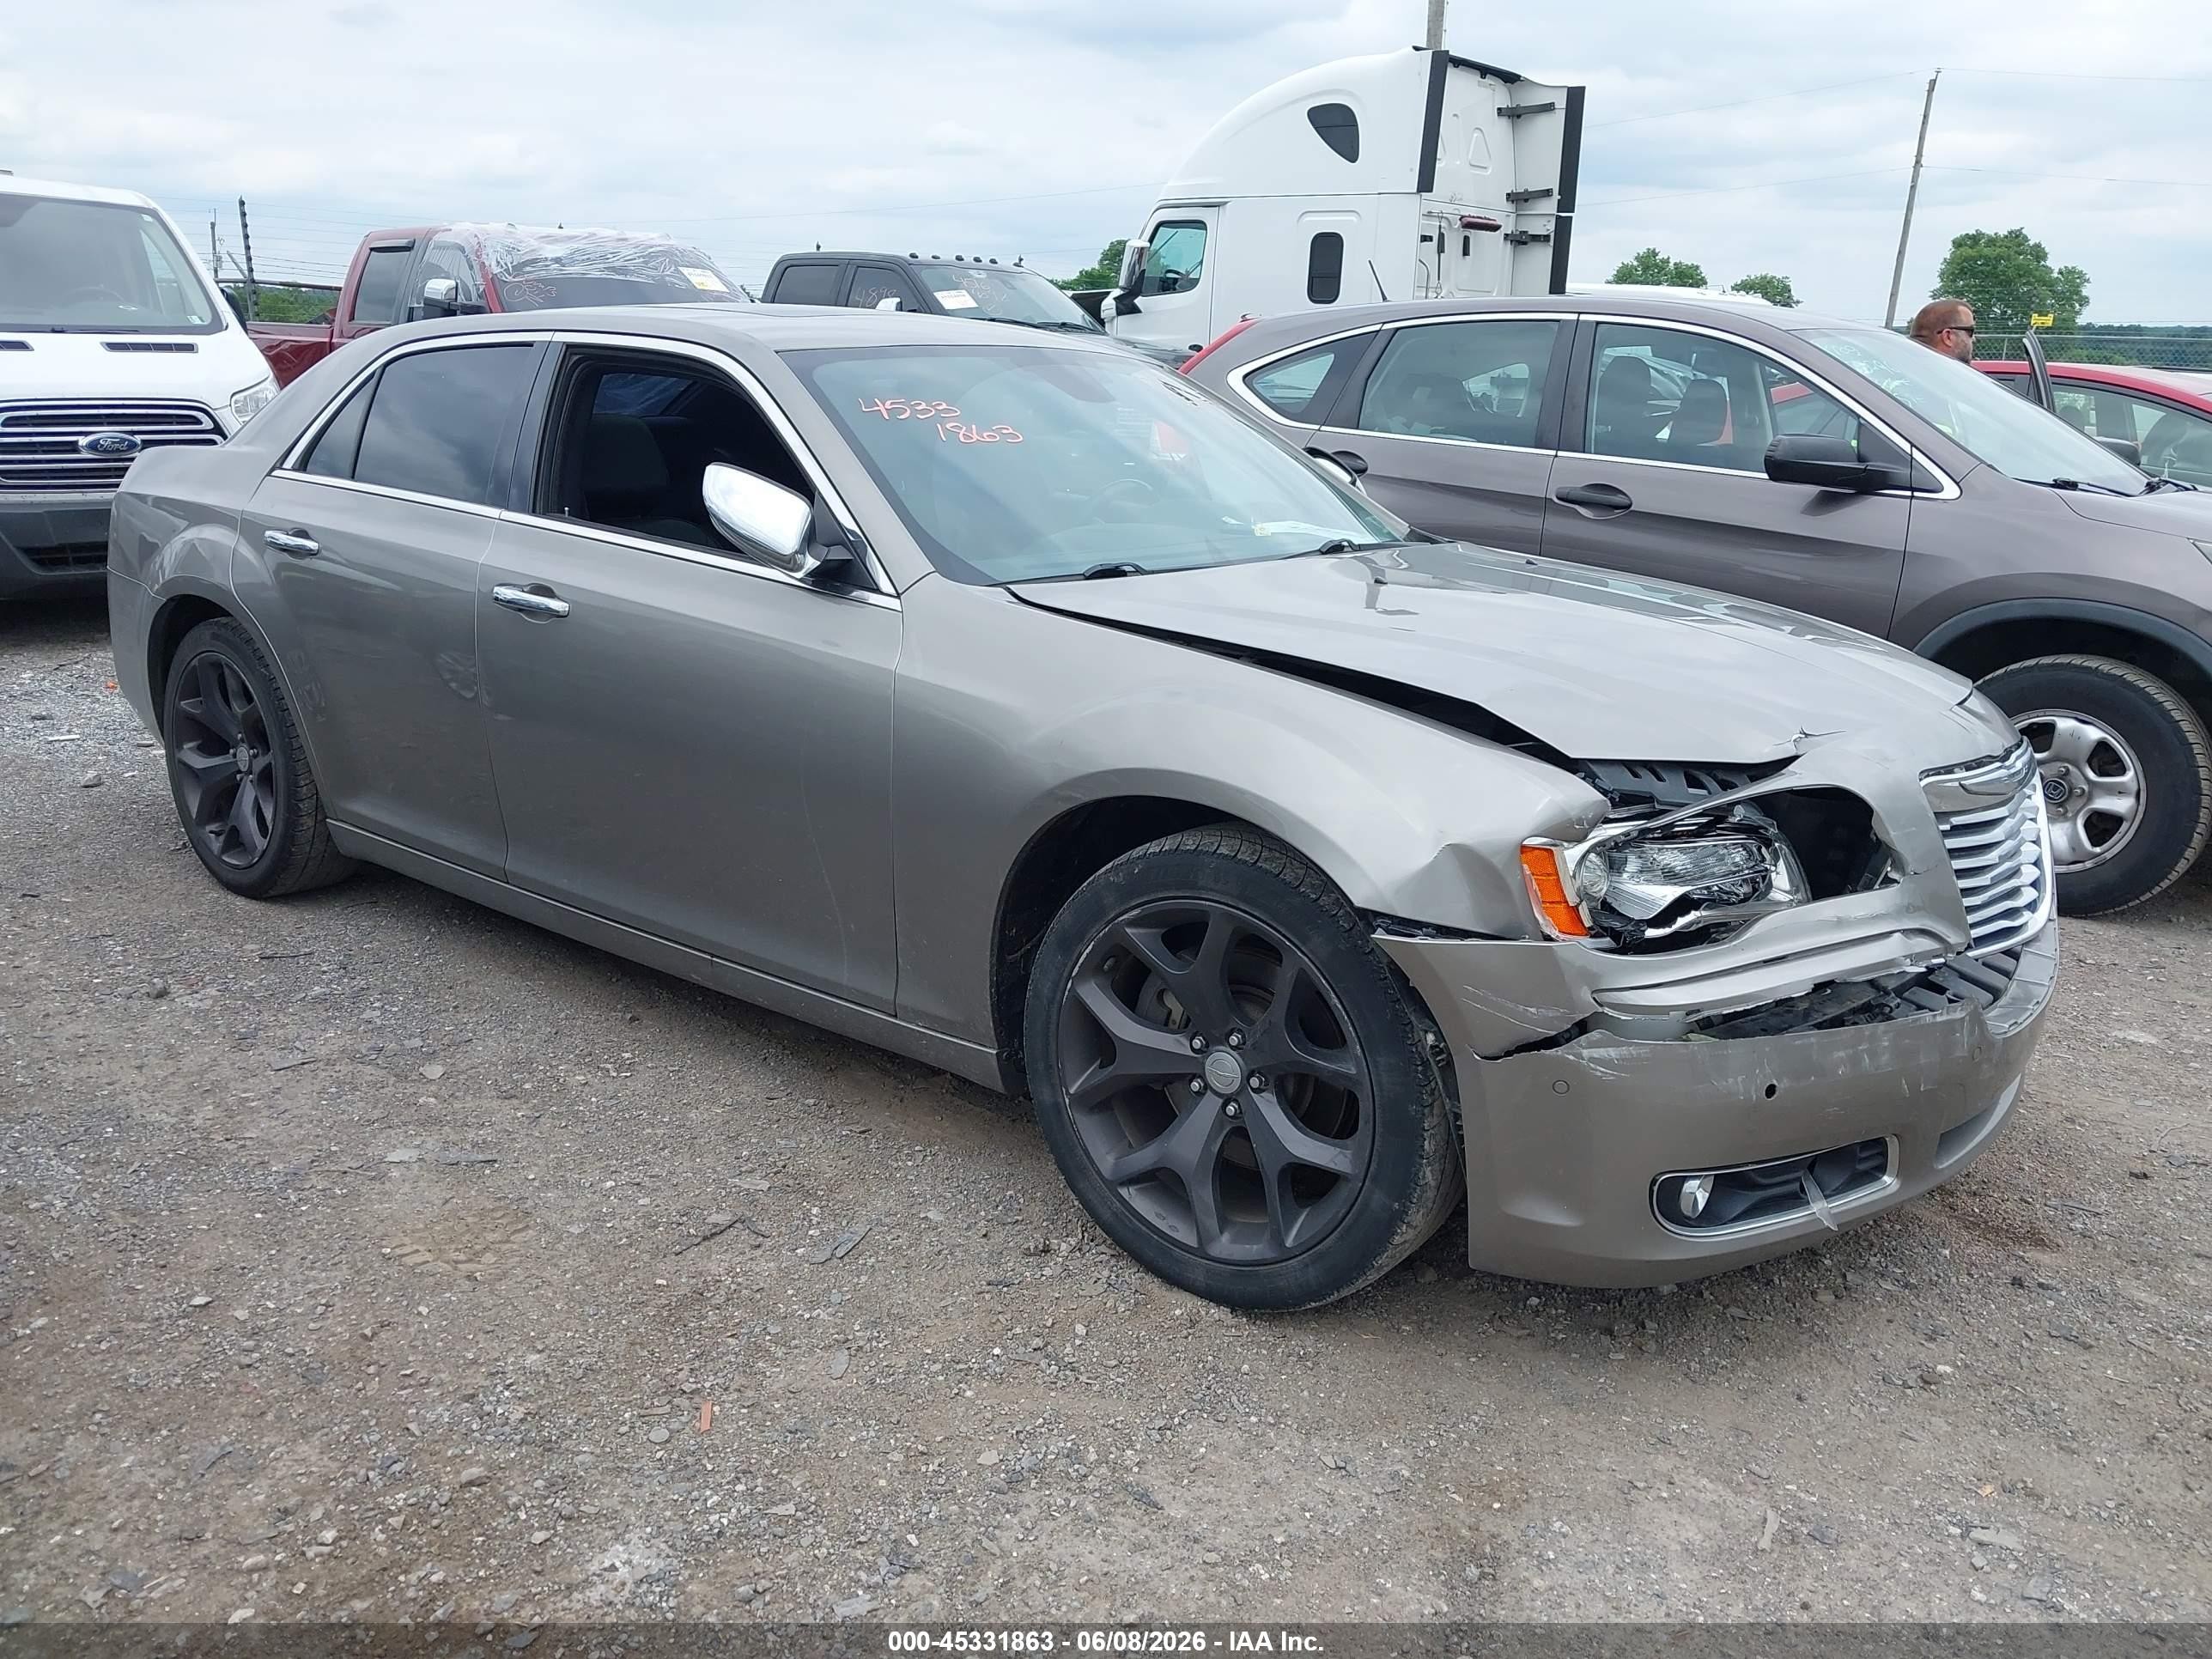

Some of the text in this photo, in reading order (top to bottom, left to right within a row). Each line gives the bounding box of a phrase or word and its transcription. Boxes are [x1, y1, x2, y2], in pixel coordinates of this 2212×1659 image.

[859, 398, 961, 419] 4533
[936, 422, 1024, 443] 1863
[97, 438, 128, 451] Ford
